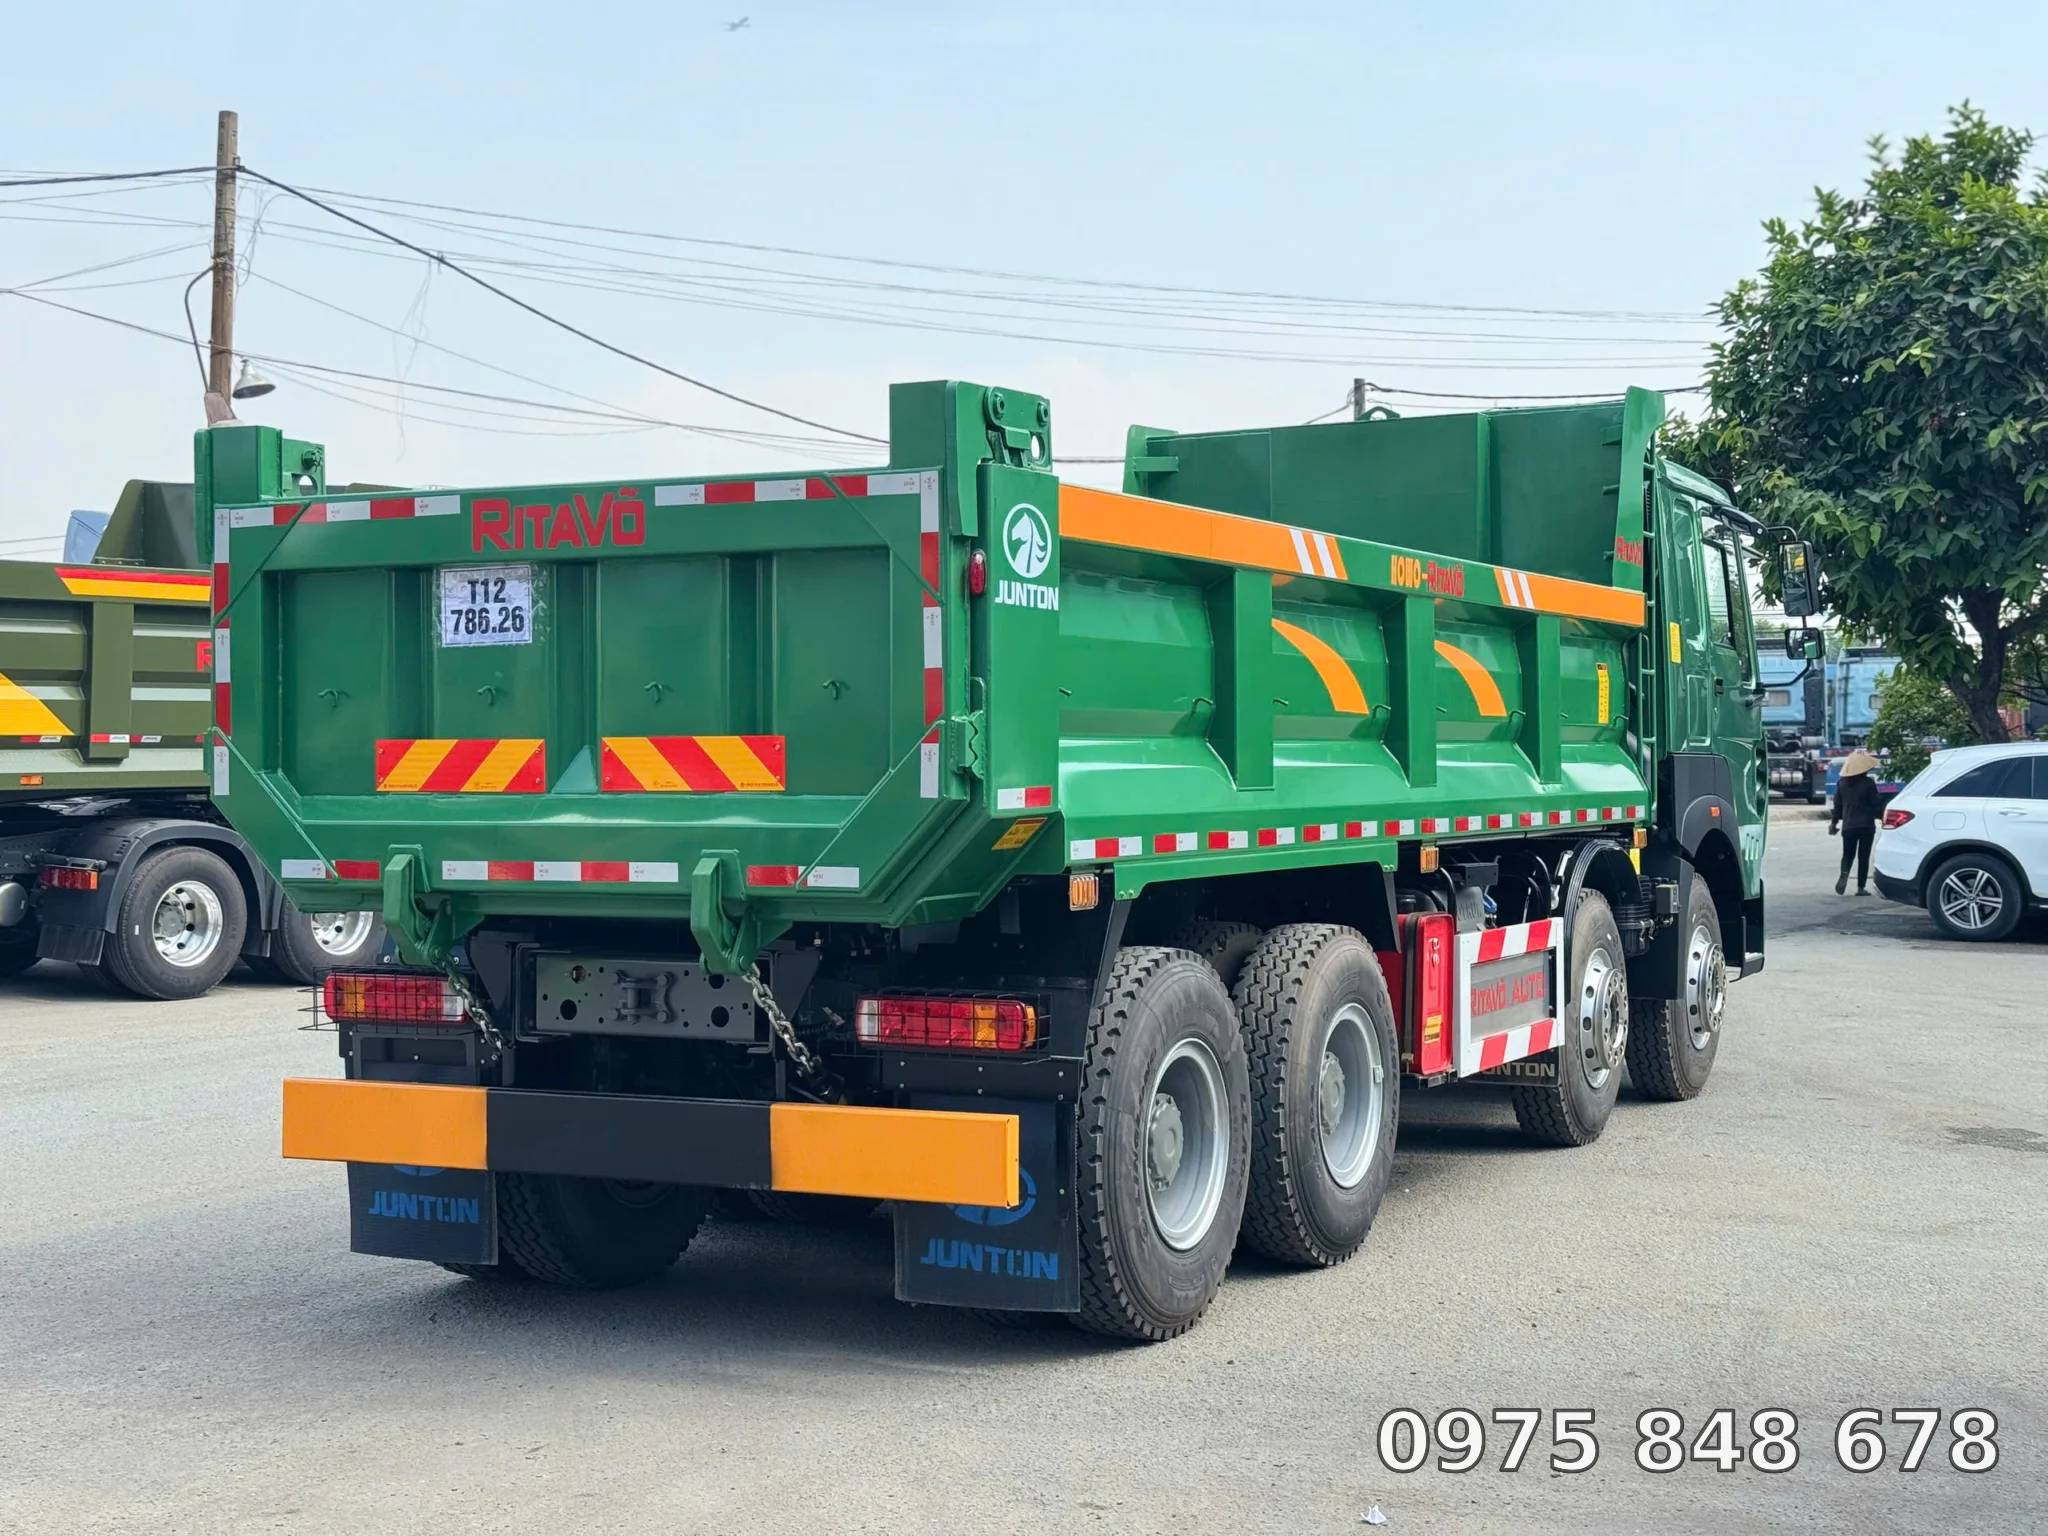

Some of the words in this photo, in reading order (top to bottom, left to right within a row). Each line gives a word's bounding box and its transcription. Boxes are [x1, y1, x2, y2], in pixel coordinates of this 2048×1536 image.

[467, 577, 507, 605] T12
[994, 579, 1059, 611] JUNTON
[450, 606, 525, 635] 786.26
[1512, 971, 1544, 1005] AUTO
[368, 1190, 479, 1224] JUNTON
[920, 1237, 1058, 1280] JUNTON
